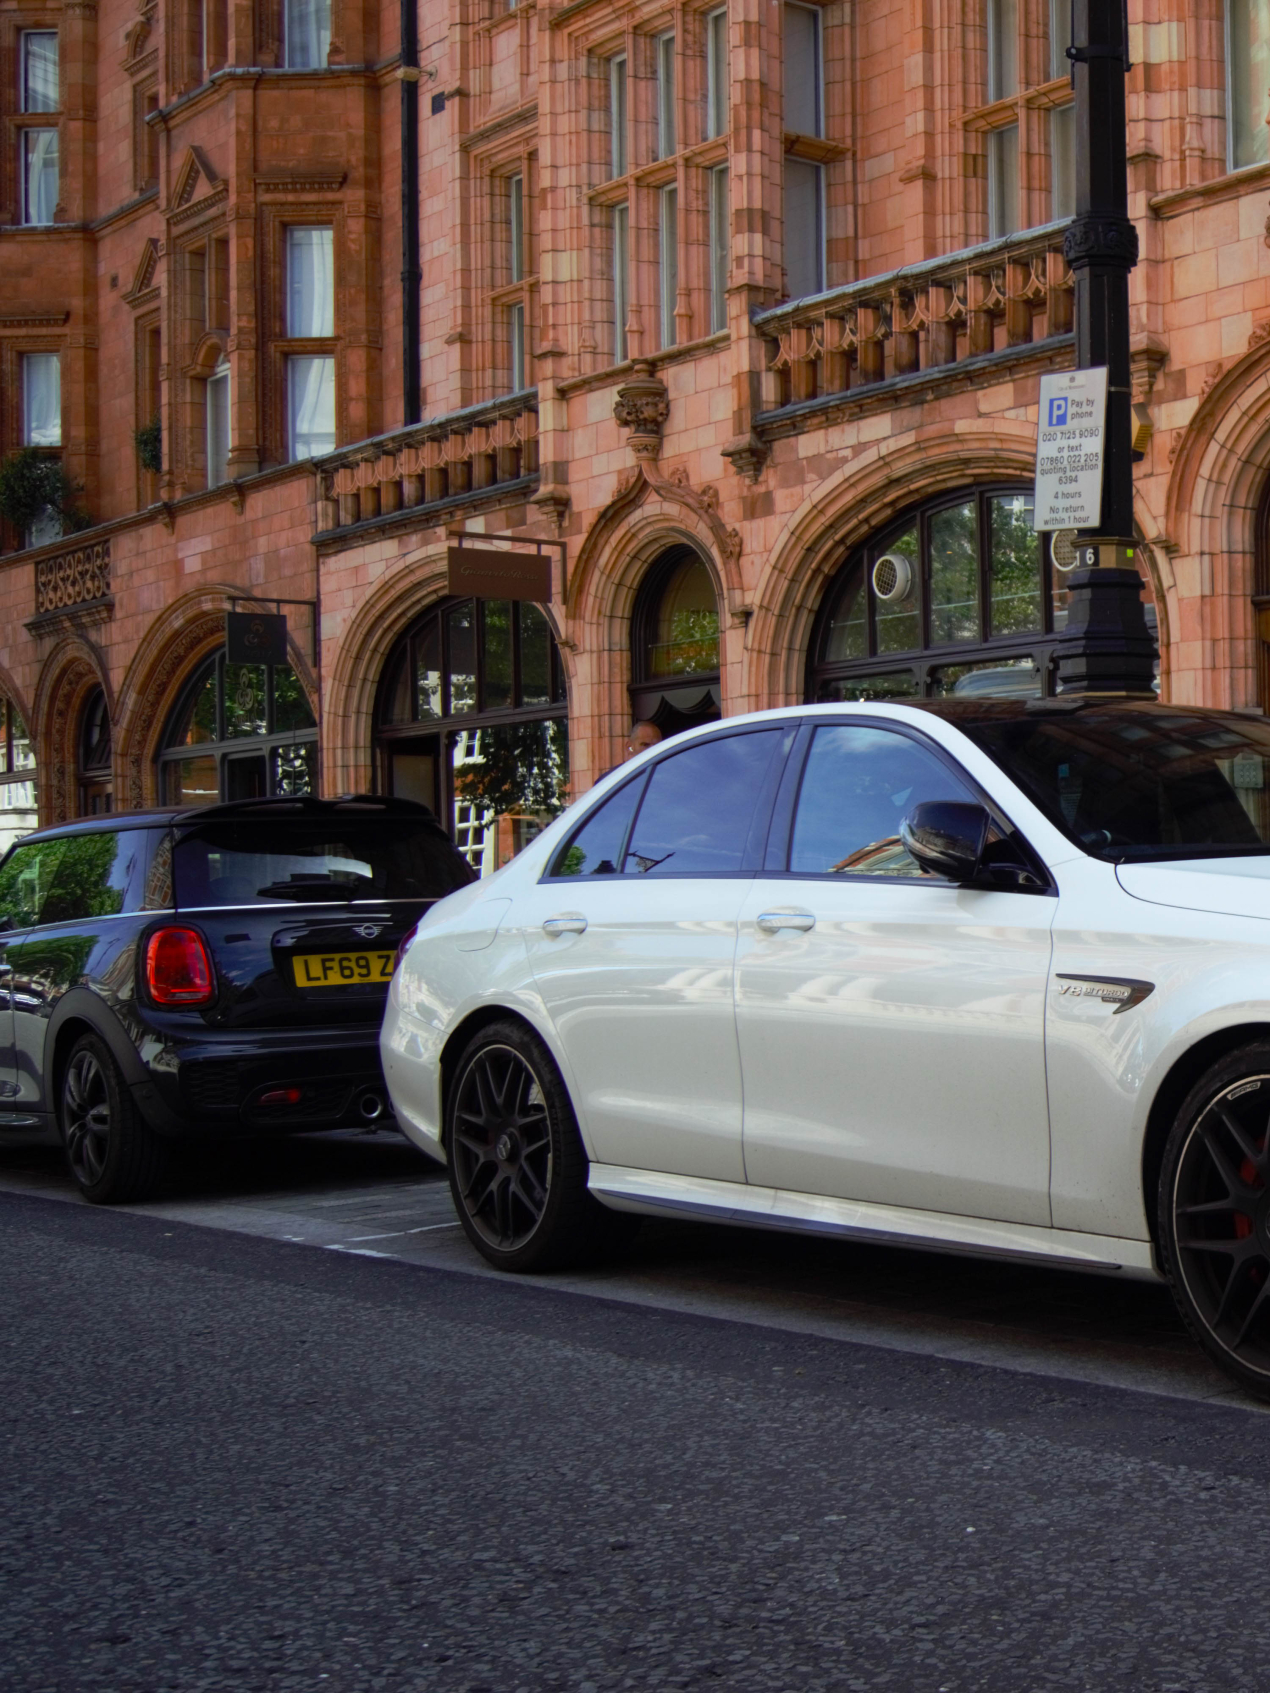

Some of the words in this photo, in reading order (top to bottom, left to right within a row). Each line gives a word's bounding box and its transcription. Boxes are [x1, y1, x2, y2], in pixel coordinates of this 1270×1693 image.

[1071, 399, 1084, 409] Pay
[1086, 398, 1095, 407] by
[1071, 411, 1093, 421] phone
[1042, 432, 1057, 442] 020
[1060, 430, 1077, 440] 7125
[1079, 428, 1100, 438] 9090
[1067, 443, 1082, 452] text
[1040, 456, 1064, 466] 07860
[1067, 454, 1082, 464] 022
[1084, 453, 1099, 462] 205
[1040, 465, 1067, 476] quoting
[1069, 462, 1098, 472] location
[1058, 475, 1078, 485] 6394
[1054, 491, 1059, 499] 4
[1062, 490, 1082, 499] hours
[1050, 506, 1059, 514] No
[1062, 505, 1084, 513] return
[1044, 515, 1065, 525] within
[1073, 514, 1090, 524] hour
[303, 956, 372, 982] LF69
[1059, 985, 1082, 996] V8
